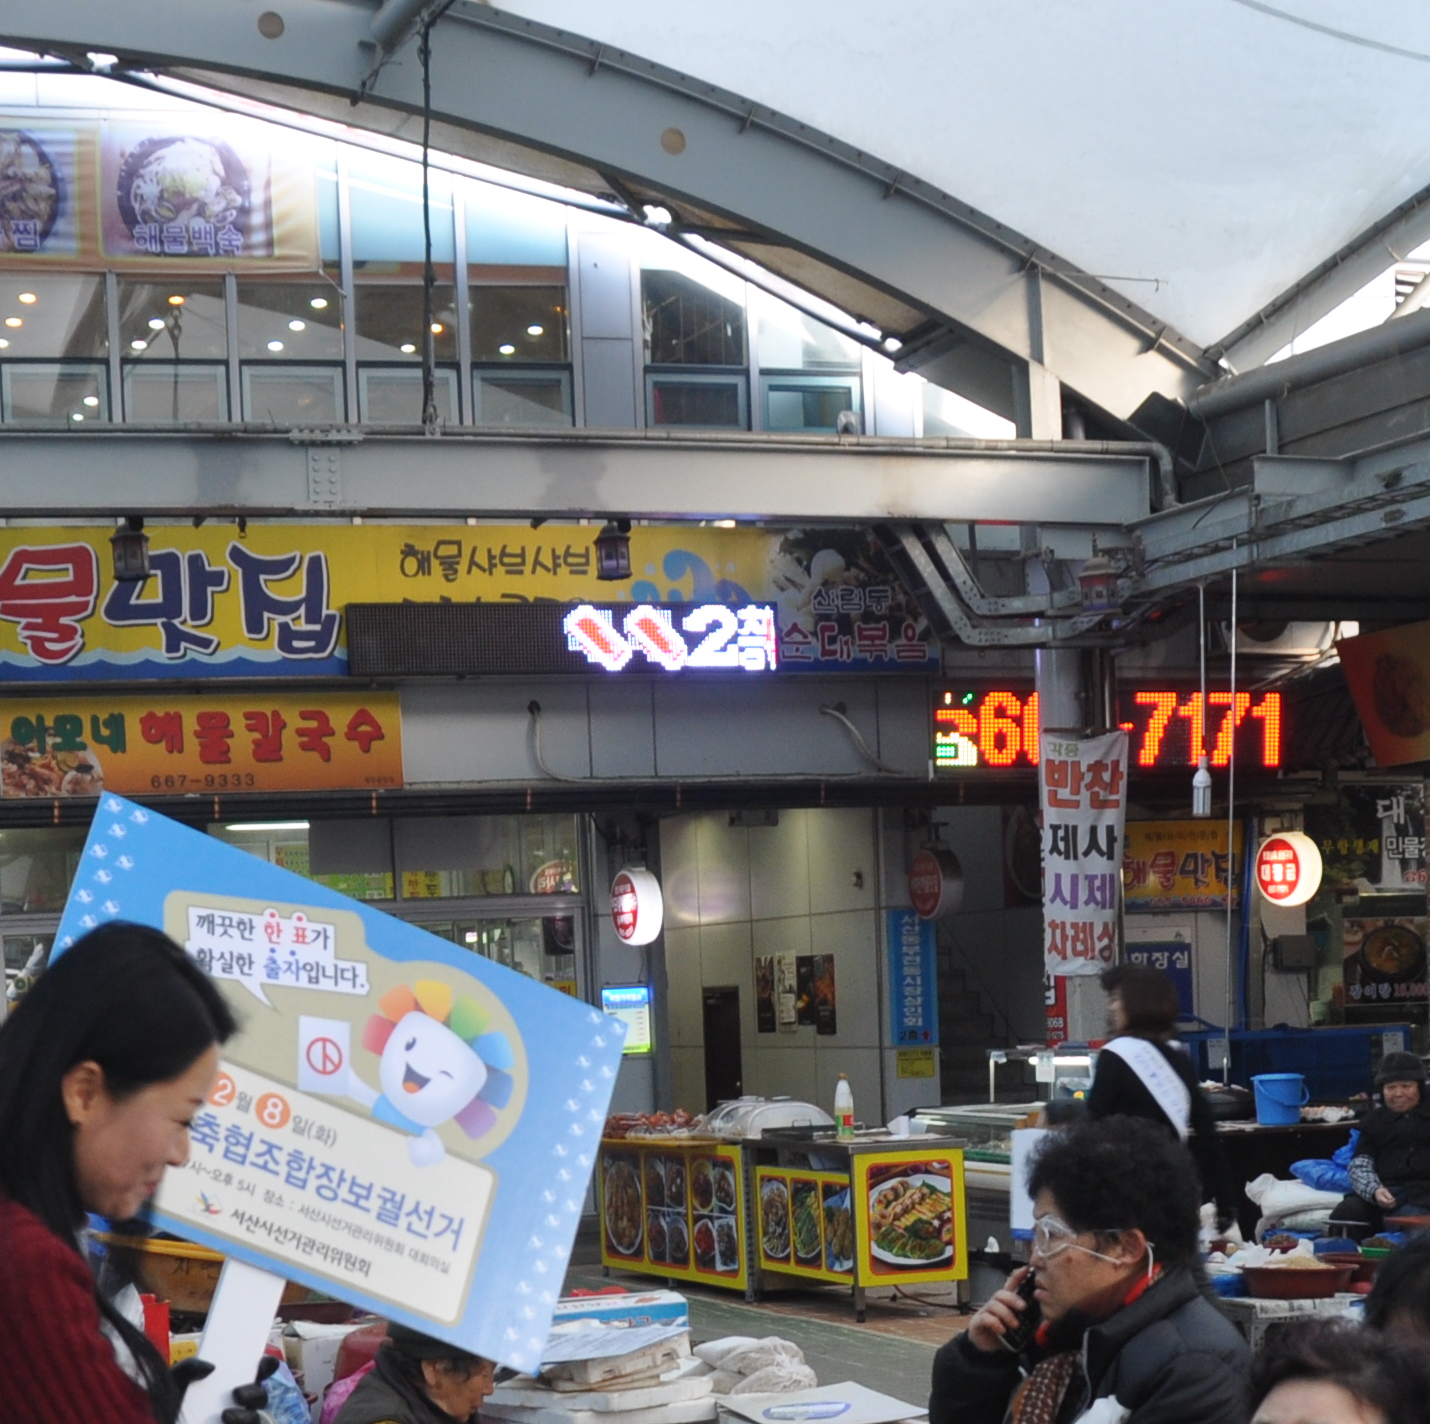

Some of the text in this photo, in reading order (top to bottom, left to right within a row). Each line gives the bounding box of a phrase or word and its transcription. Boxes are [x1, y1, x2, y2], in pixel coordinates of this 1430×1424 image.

[132, 222, 244, 255] 해물백숙
[399, 537, 591, 582] 해물샤브샤브
[810, 585, 893, 615] 신림동
[779, 621, 930, 663] 순대볶음
[139, 707, 385, 765] 해물칼국수
[150, 772, 256, 790] 667-9333
[1044, 758, 1124, 810] 반찬
[1048, 824, 1117, 862] 제사
[1049, 872, 1115, 911] 시제
[196, 914, 330, 951] 깨끗한 한 표가
[236, 1178, 256, 1197] 5시
[230, 1207, 372, 1278] 서산시선거관리위원회
